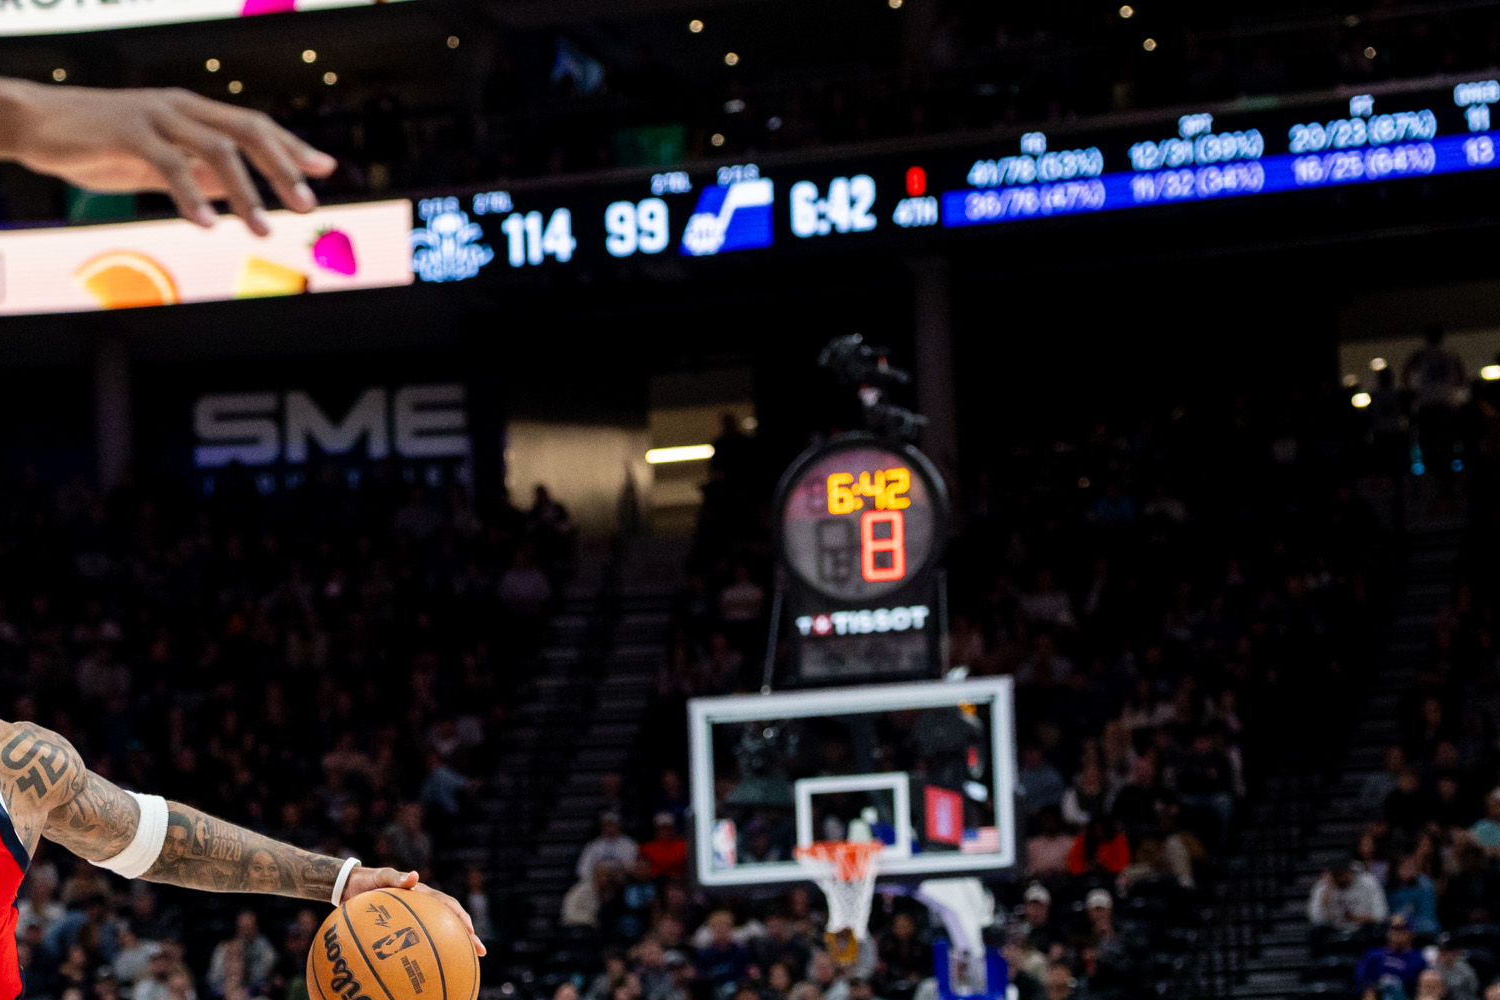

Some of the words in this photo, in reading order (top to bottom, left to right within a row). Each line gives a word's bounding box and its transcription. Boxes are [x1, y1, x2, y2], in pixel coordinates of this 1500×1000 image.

[605, 197, 670, 257] 99
[790, 174, 878, 238] 6:42
[502, 207, 577, 268] 114
[193, 384, 469, 468] SME
[827, 467, 912, 515] 6:42
[861, 509, 906, 583] 8
[211, 838, 242, 862] 2020
